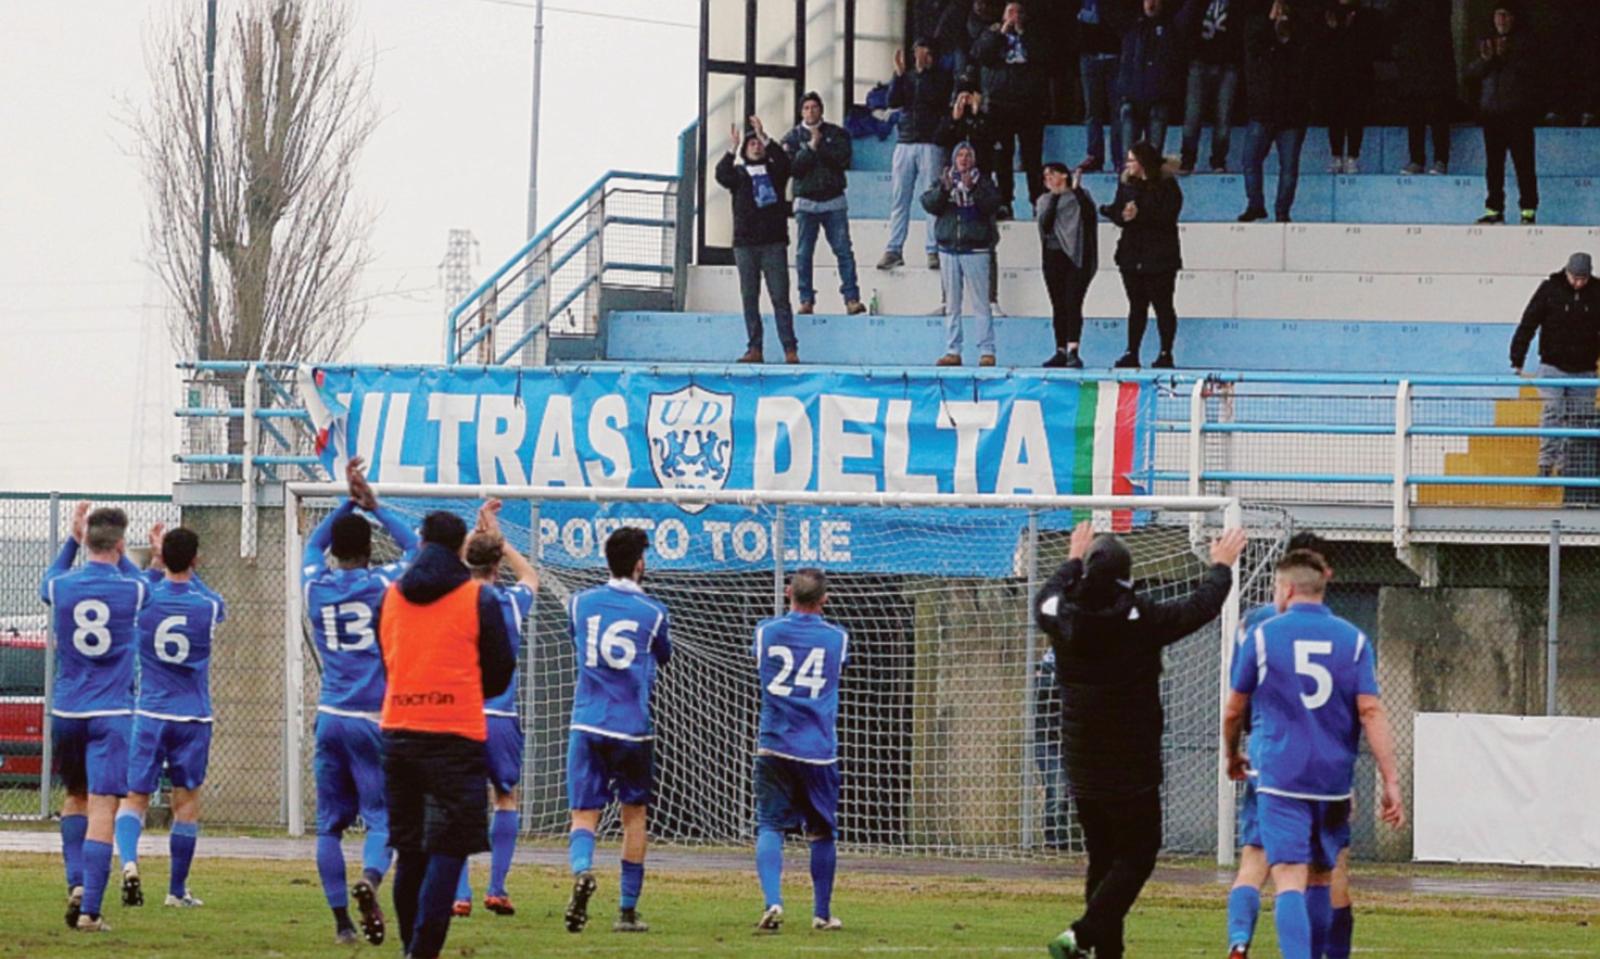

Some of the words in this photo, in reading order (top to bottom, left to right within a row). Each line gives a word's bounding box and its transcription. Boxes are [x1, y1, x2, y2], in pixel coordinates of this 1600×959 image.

[333, 392, 633, 488] ULTRAS
[754, 395, 1056, 494] DELTA
[72, 600, 112, 656] 8
[153, 615, 190, 664] 6
[321, 602, 376, 651] 13
[586, 615, 639, 670] 16
[767, 645, 827, 698] 24
[1293, 640, 1334, 709] 5
